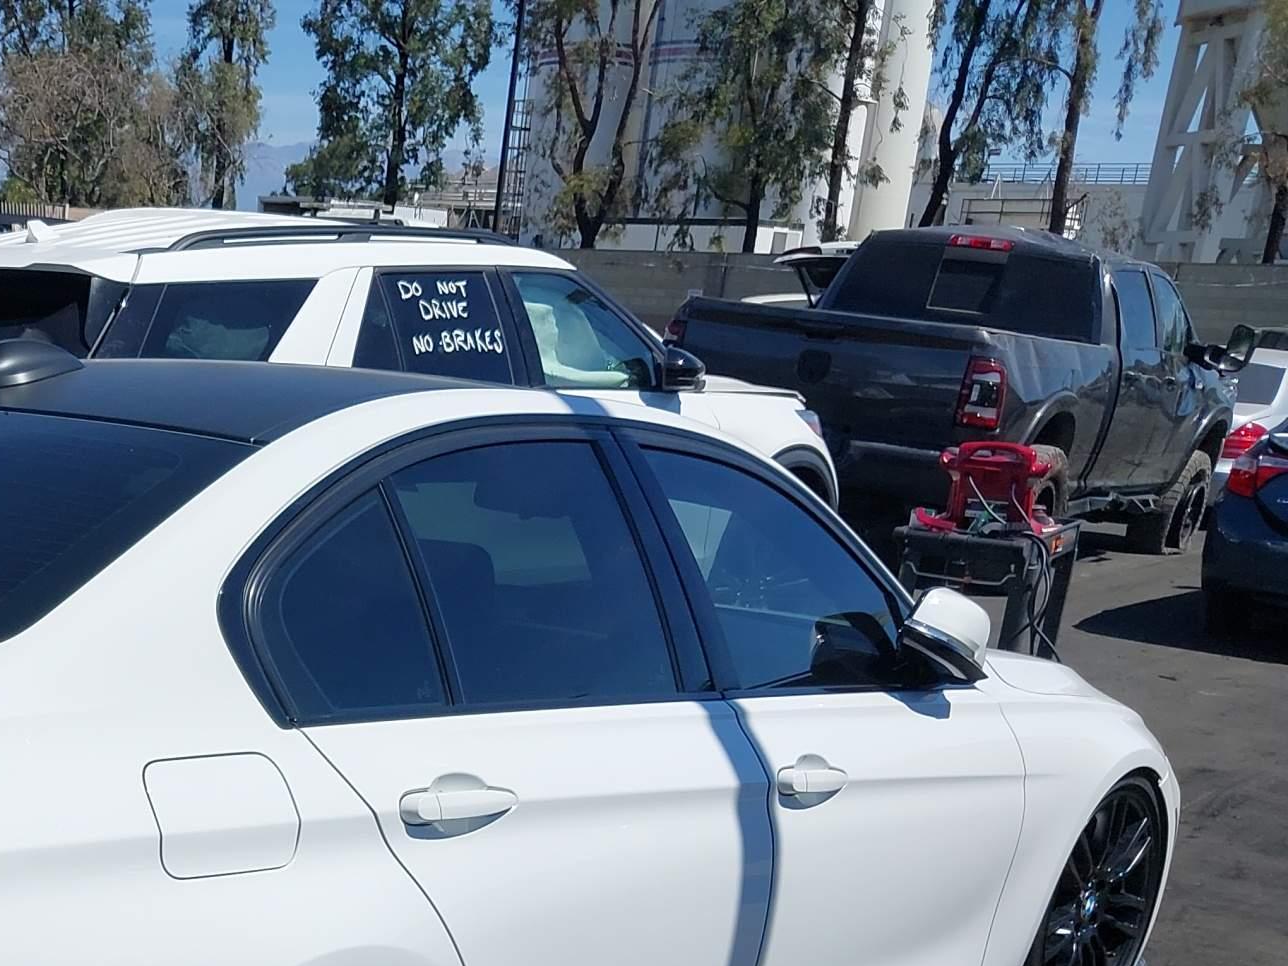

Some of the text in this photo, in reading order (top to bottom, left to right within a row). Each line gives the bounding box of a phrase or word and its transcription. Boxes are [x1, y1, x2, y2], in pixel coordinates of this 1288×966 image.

[397, 280, 467, 300] DO NOT
[419, 299, 468, 320] DRIVE
[412, 328, 504, 355] NO BRAKES
